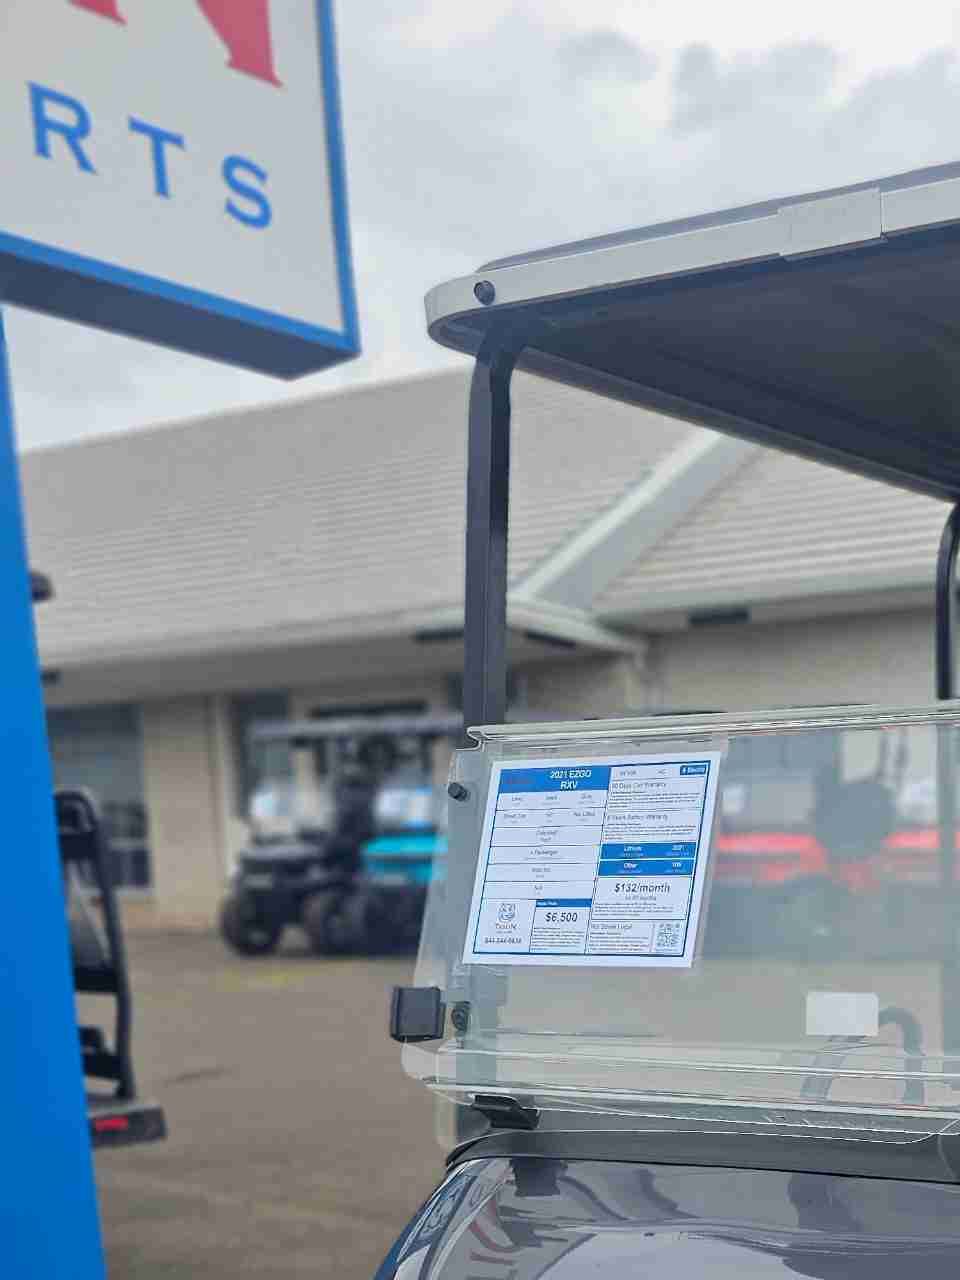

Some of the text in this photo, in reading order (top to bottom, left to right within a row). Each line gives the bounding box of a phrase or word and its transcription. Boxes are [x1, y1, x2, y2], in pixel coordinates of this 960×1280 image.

[28, 81, 272, 229] RTS
[560, 781, 578, 790] RXV
[614, 882, 670, 893] $132/month
